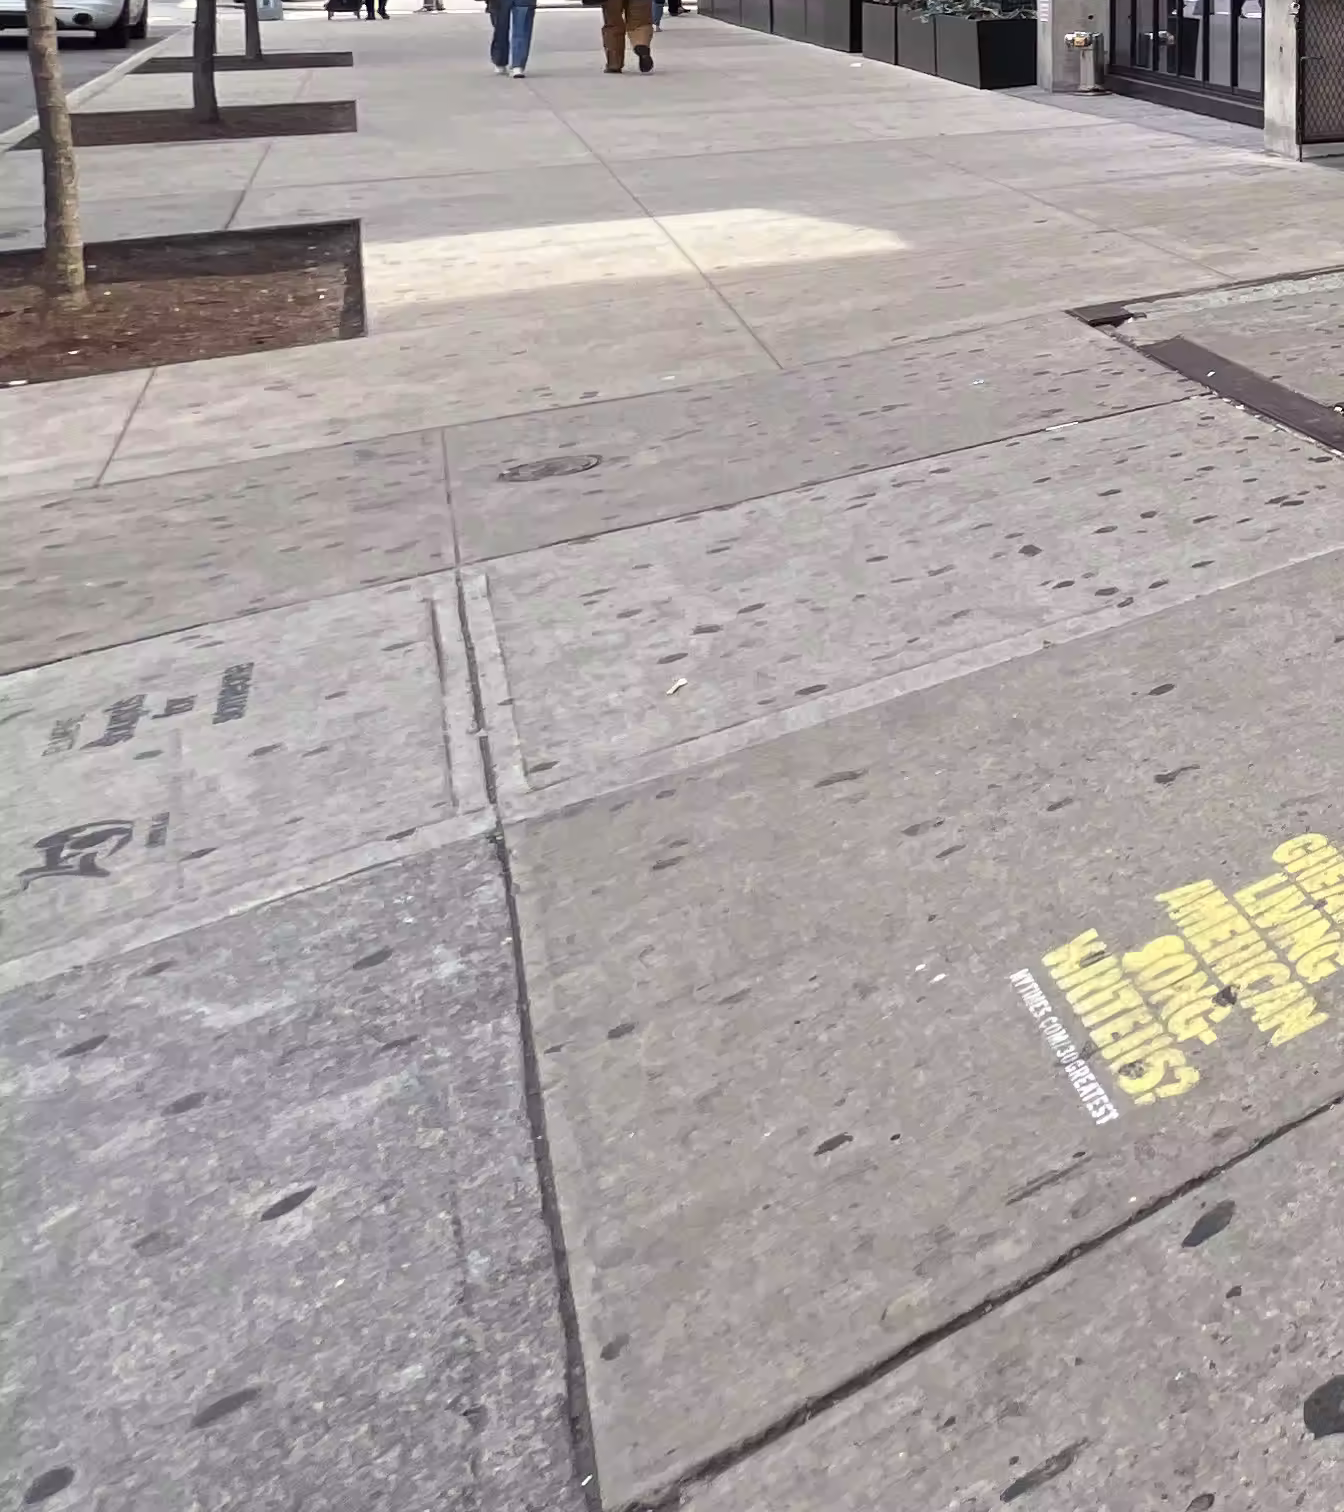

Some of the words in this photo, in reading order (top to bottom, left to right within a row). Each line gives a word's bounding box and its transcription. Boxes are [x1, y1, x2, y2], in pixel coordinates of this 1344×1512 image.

[1041, 928, 1200, 1105] WRITERS?
[1121, 934, 1232, 1046] SONG-
[1154, 879, 1330, 1047] AMERICAN
